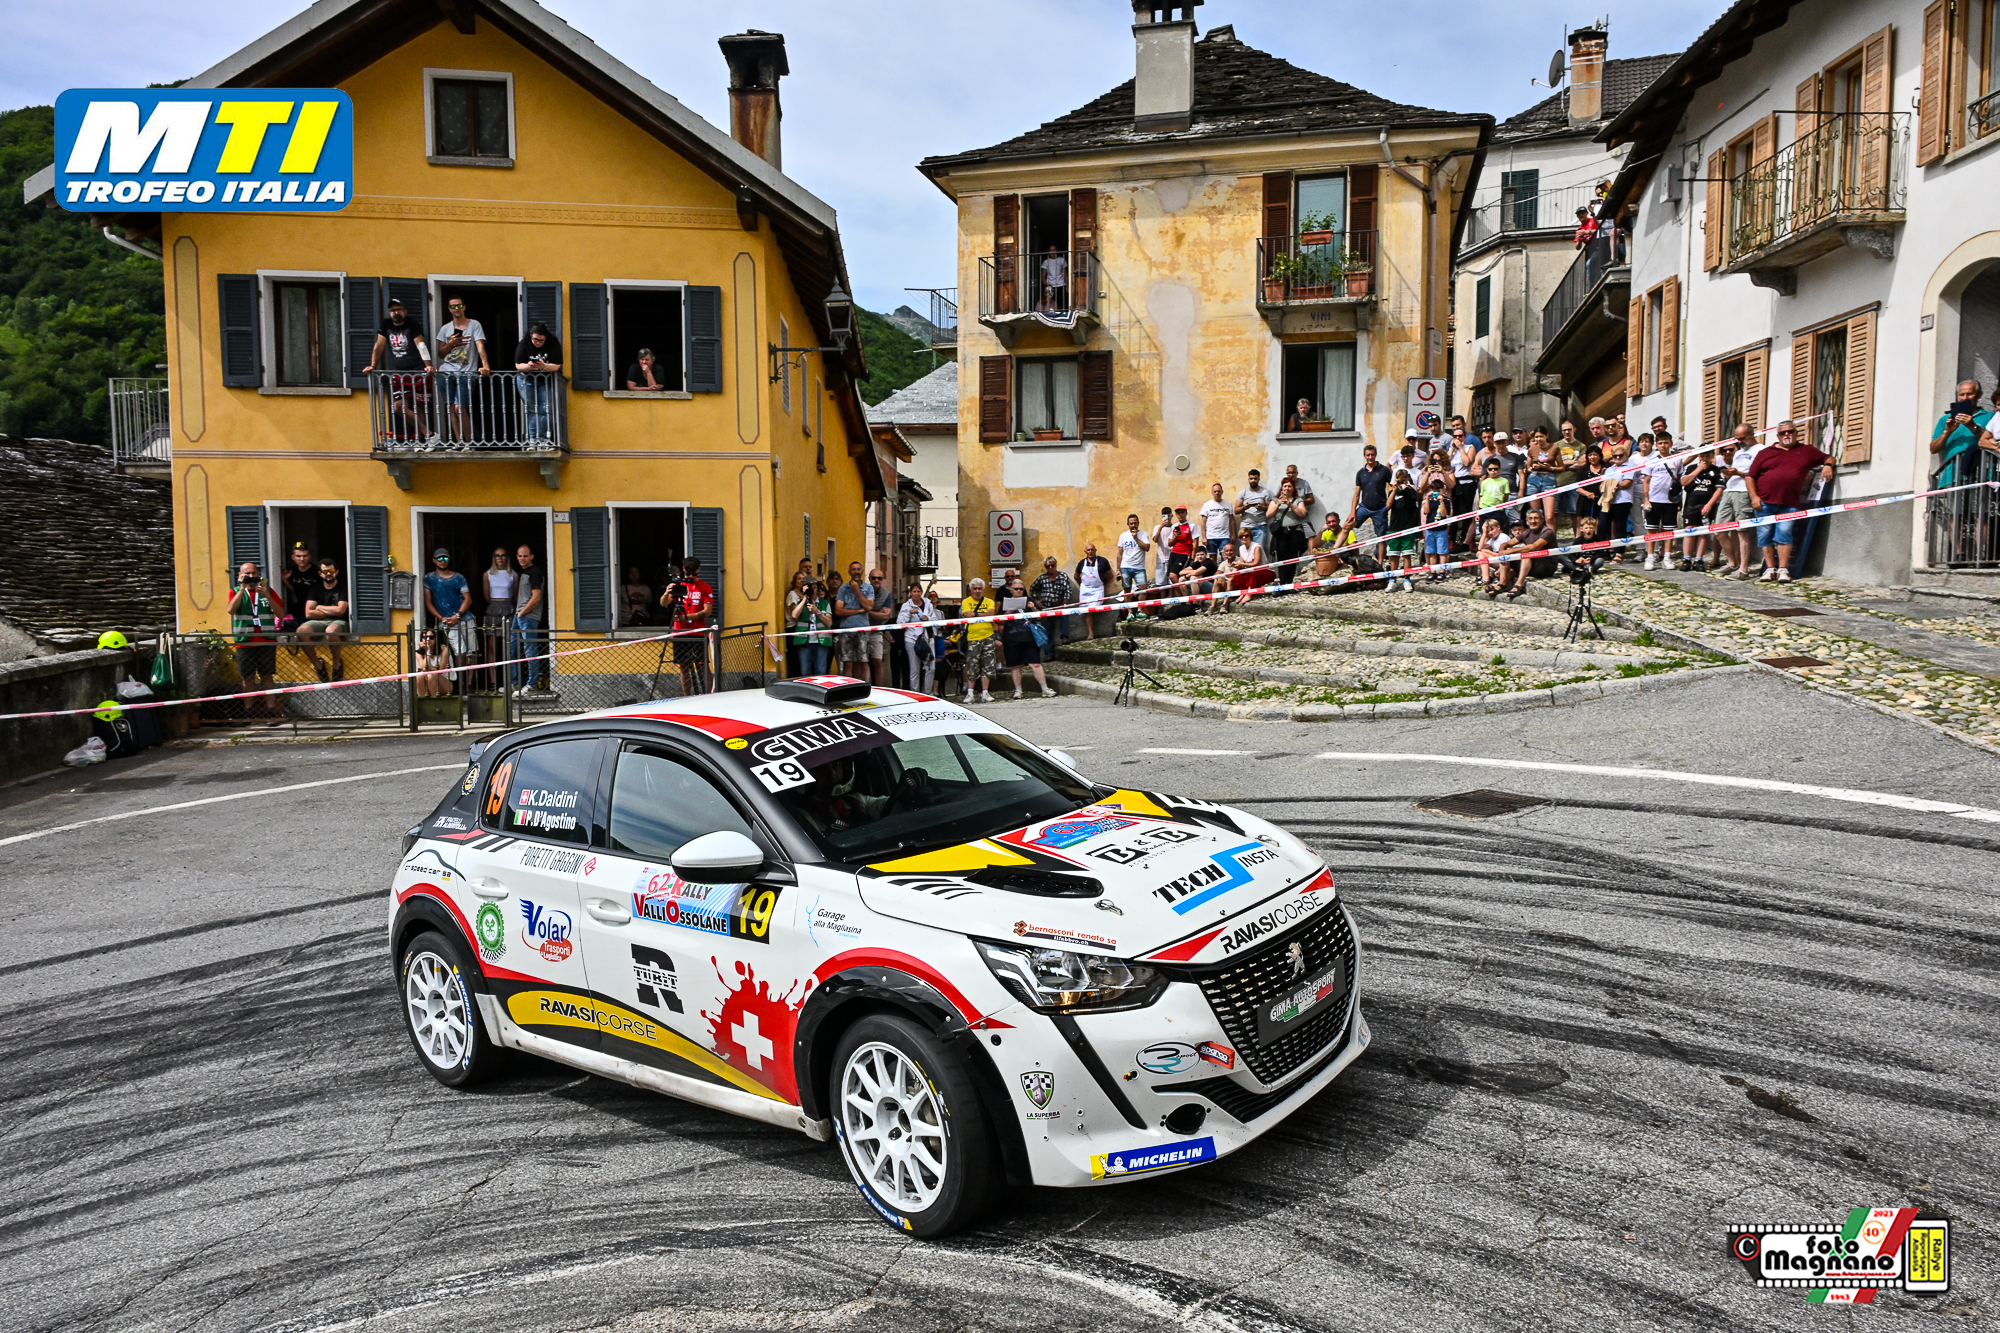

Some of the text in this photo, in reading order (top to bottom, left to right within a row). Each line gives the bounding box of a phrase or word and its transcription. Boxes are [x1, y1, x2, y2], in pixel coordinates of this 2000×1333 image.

[1310, 312, 1331, 321] VINI
[751, 711, 978, 763] GIMA AUTOSPORT
[760, 762, 805, 787] 19
[486, 762, 512, 815] 19
[527, 789, 577, 808] K.Daldini
[525, 810, 576, 831] P.D'Agostino
[1052, 824, 1084, 834] 62
[520, 846, 555, 870] PORETTI
[1238, 848, 1280, 868] INSTA
[670, 877, 713, 901] RALLY
[1152, 863, 1226, 904] TECH
[521, 899, 567, 942] Volar
[738, 888, 775, 937] 19
[817, 908, 846, 922] Garage
[813, 920, 862, 934] alla Magliasina
[1029, 923, 1117, 945] bernasconi renato sa
[544, 942, 570, 956] Trasporti
[1270, 968, 1337, 1023] GIMA AUTOSPORT
[1129, 1148, 1203, 1168] MICHELIN
